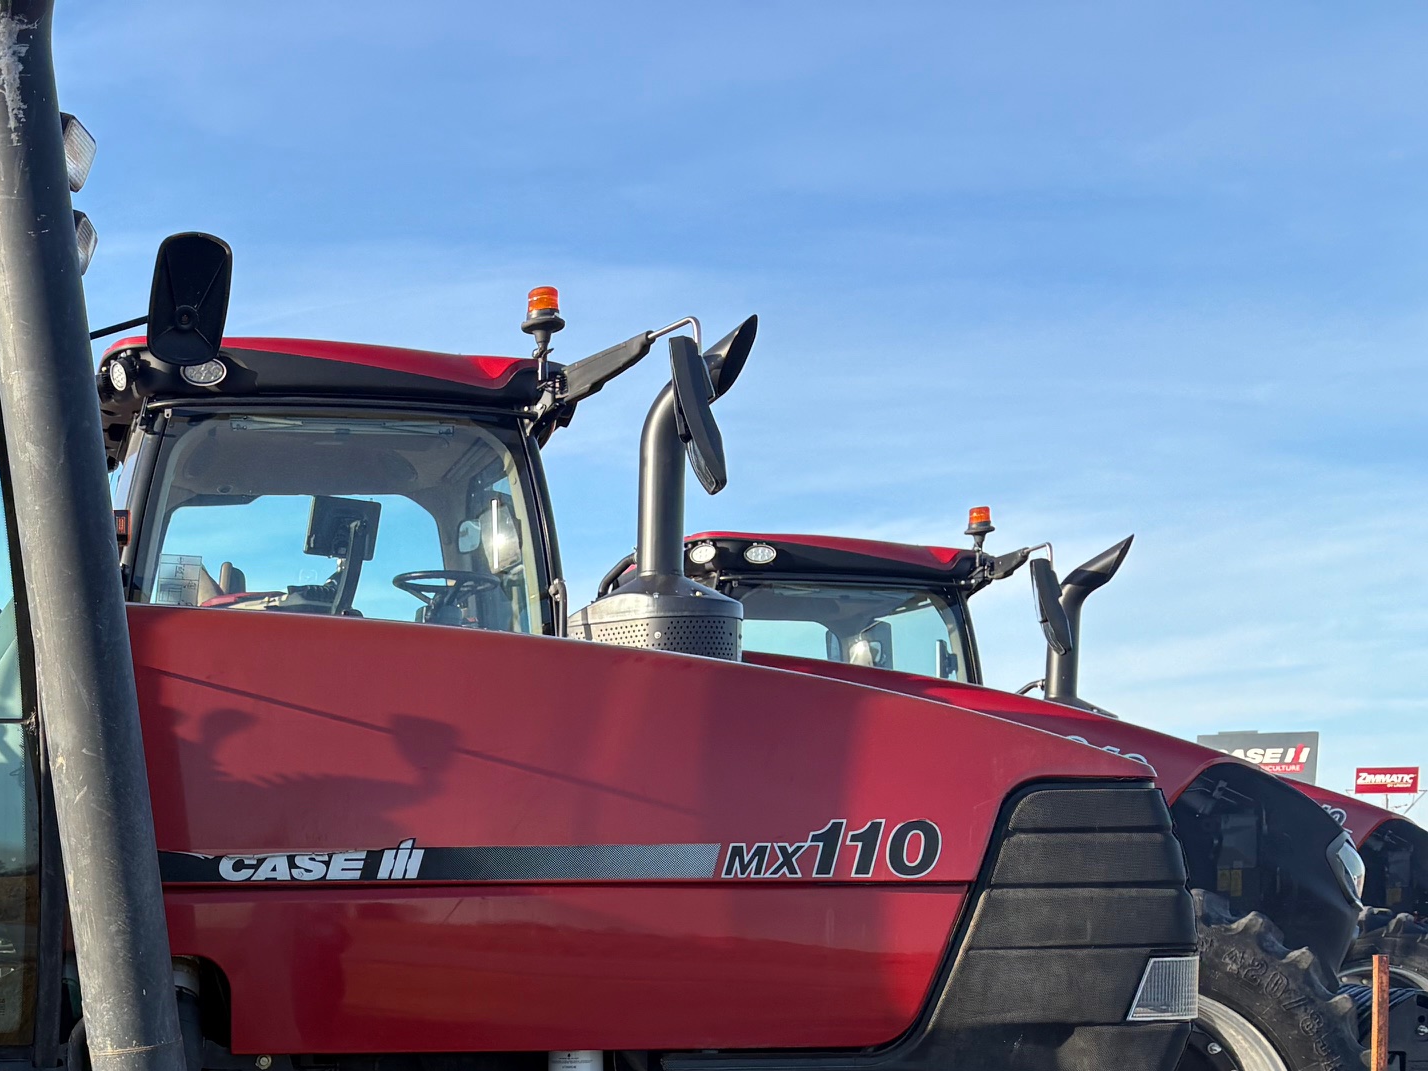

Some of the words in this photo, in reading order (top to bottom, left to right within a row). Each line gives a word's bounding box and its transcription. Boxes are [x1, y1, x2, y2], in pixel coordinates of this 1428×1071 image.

[1219, 747, 1284, 764] ASE
[1357, 773, 1414, 784] ZIMMATIC
[722, 818, 943, 879] MX110
[218, 853, 367, 882] CASE
